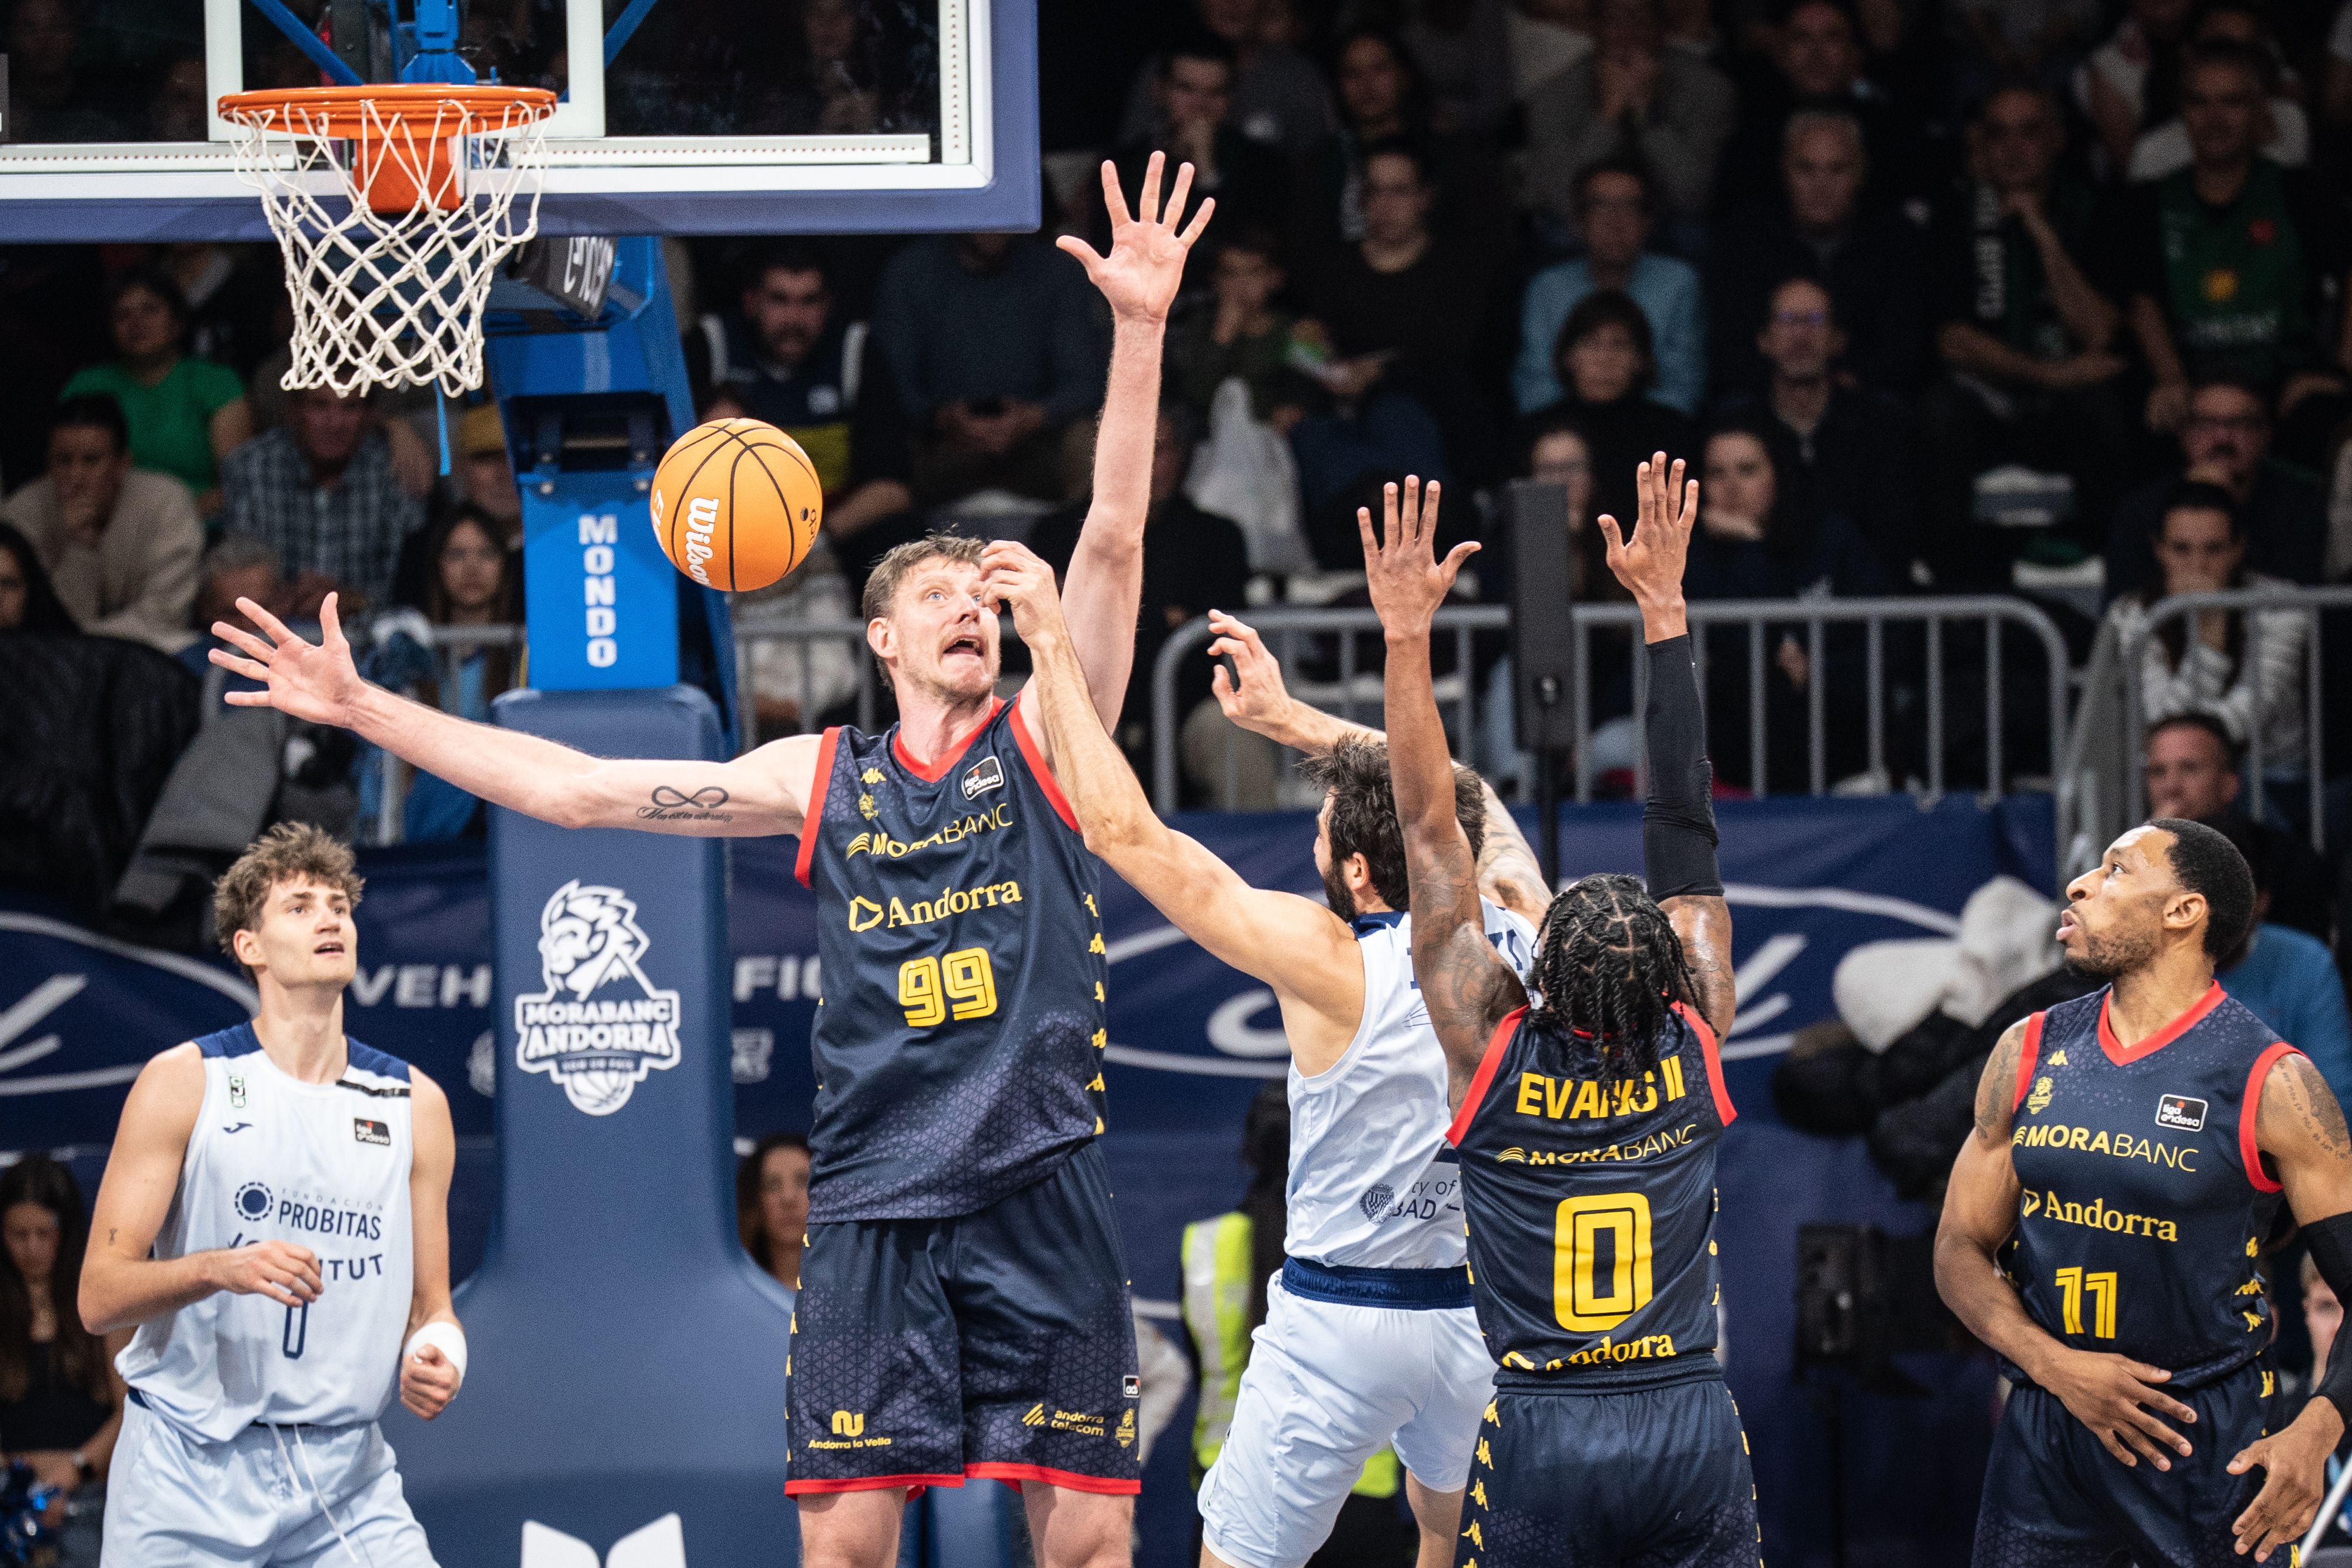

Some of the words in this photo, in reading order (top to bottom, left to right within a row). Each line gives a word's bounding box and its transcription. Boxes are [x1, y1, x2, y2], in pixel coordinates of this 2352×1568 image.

[578, 513, 617, 668] MONDO
[887, 881, 1023, 928] Andorra
[353, 963, 493, 1008] VEH
[898, 947, 997, 1027] 99
[524, 1000, 671, 1025] MORABANC
[525, 1022, 671, 1059] ANDORRA
[1516, 1071, 1658, 1119] EVANS
[2163, 1104, 2182, 1115] liga
[2160, 1114, 2200, 1127] endesa
[2024, 1124, 2199, 1172] MORABANC
[279, 1200, 382, 1241] PROBITAS
[2043, 1191, 2178, 1242] Andorra
[1553, 1192, 1652, 1332] 0
[2055, 1266, 2117, 1339] 11
[1050, 1419, 1105, 1437] telecom
[1054, 1409, 1105, 1424] andorra
[808, 1439, 851, 1450] Andorra
[853, 1439, 864, 1448] la
[864, 1436, 892, 1447] Vella
